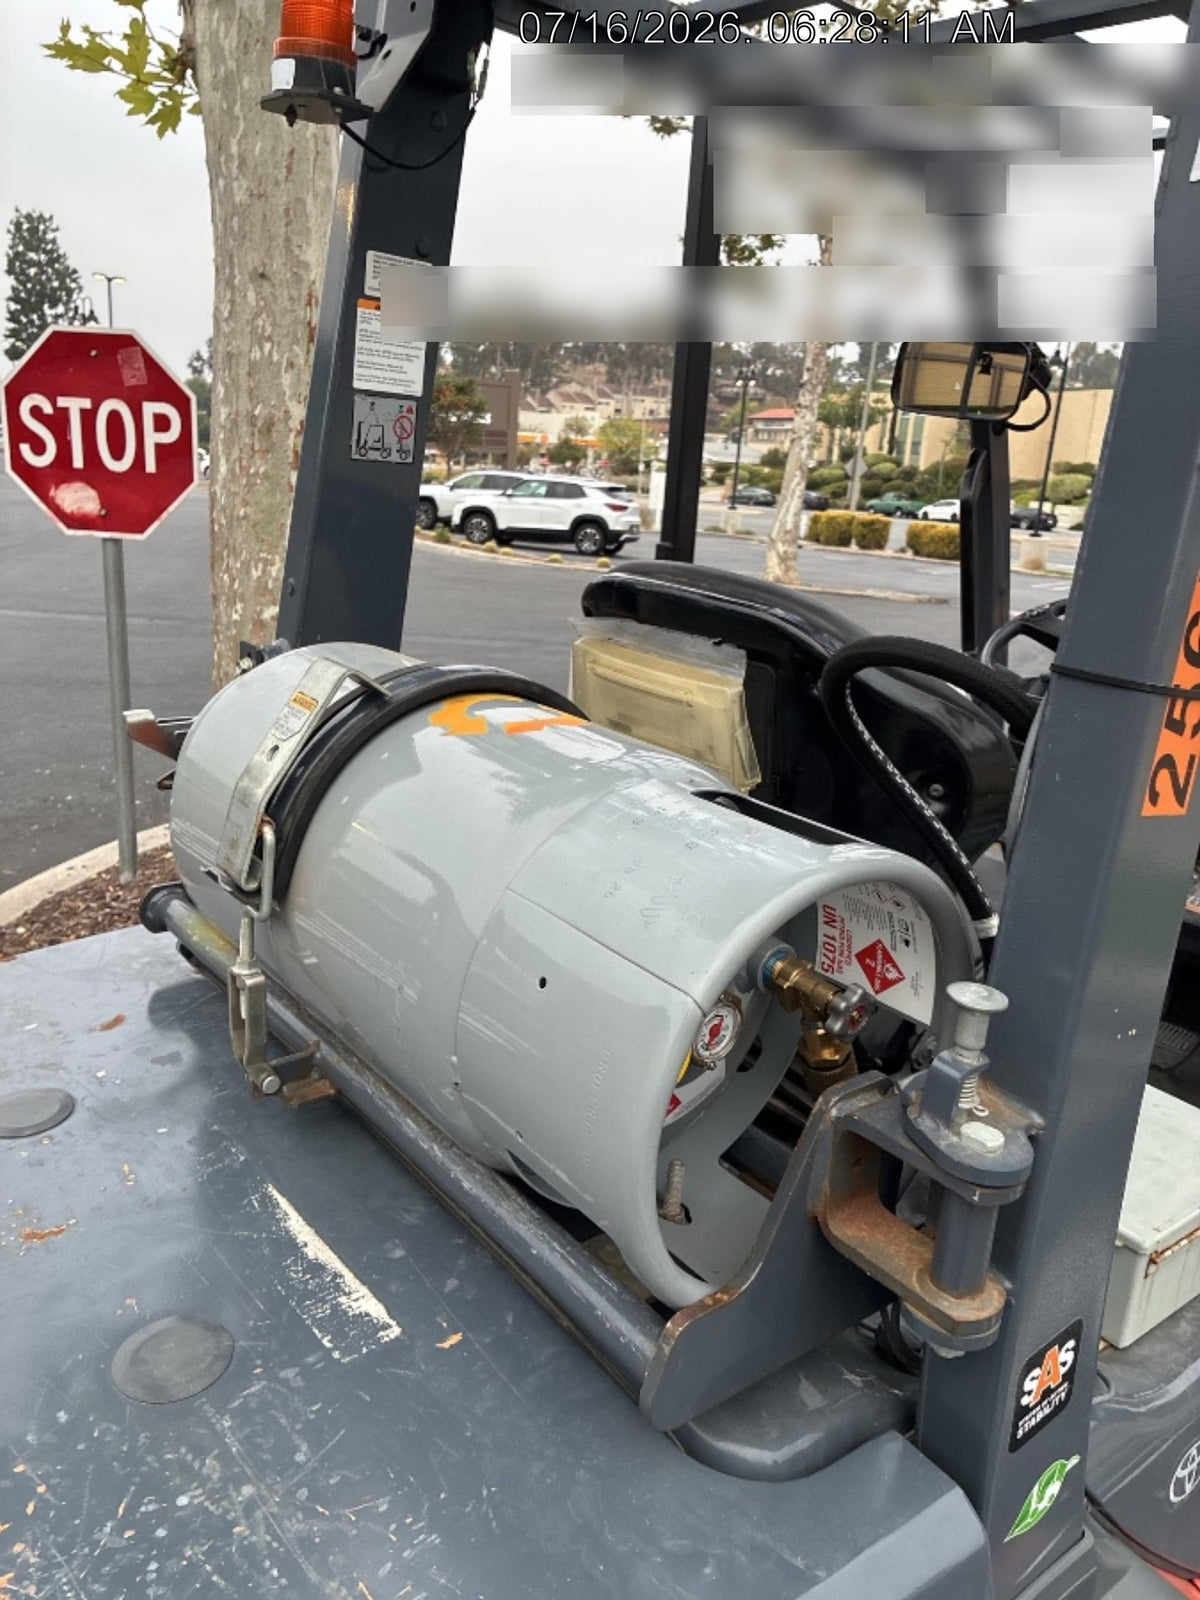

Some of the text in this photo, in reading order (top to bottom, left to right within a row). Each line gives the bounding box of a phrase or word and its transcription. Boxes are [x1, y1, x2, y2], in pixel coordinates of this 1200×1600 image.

[19, 393, 182, 474] STOP
[820, 904, 837, 976] UN 1075
[1020, 1339, 1076, 1407] SAS
